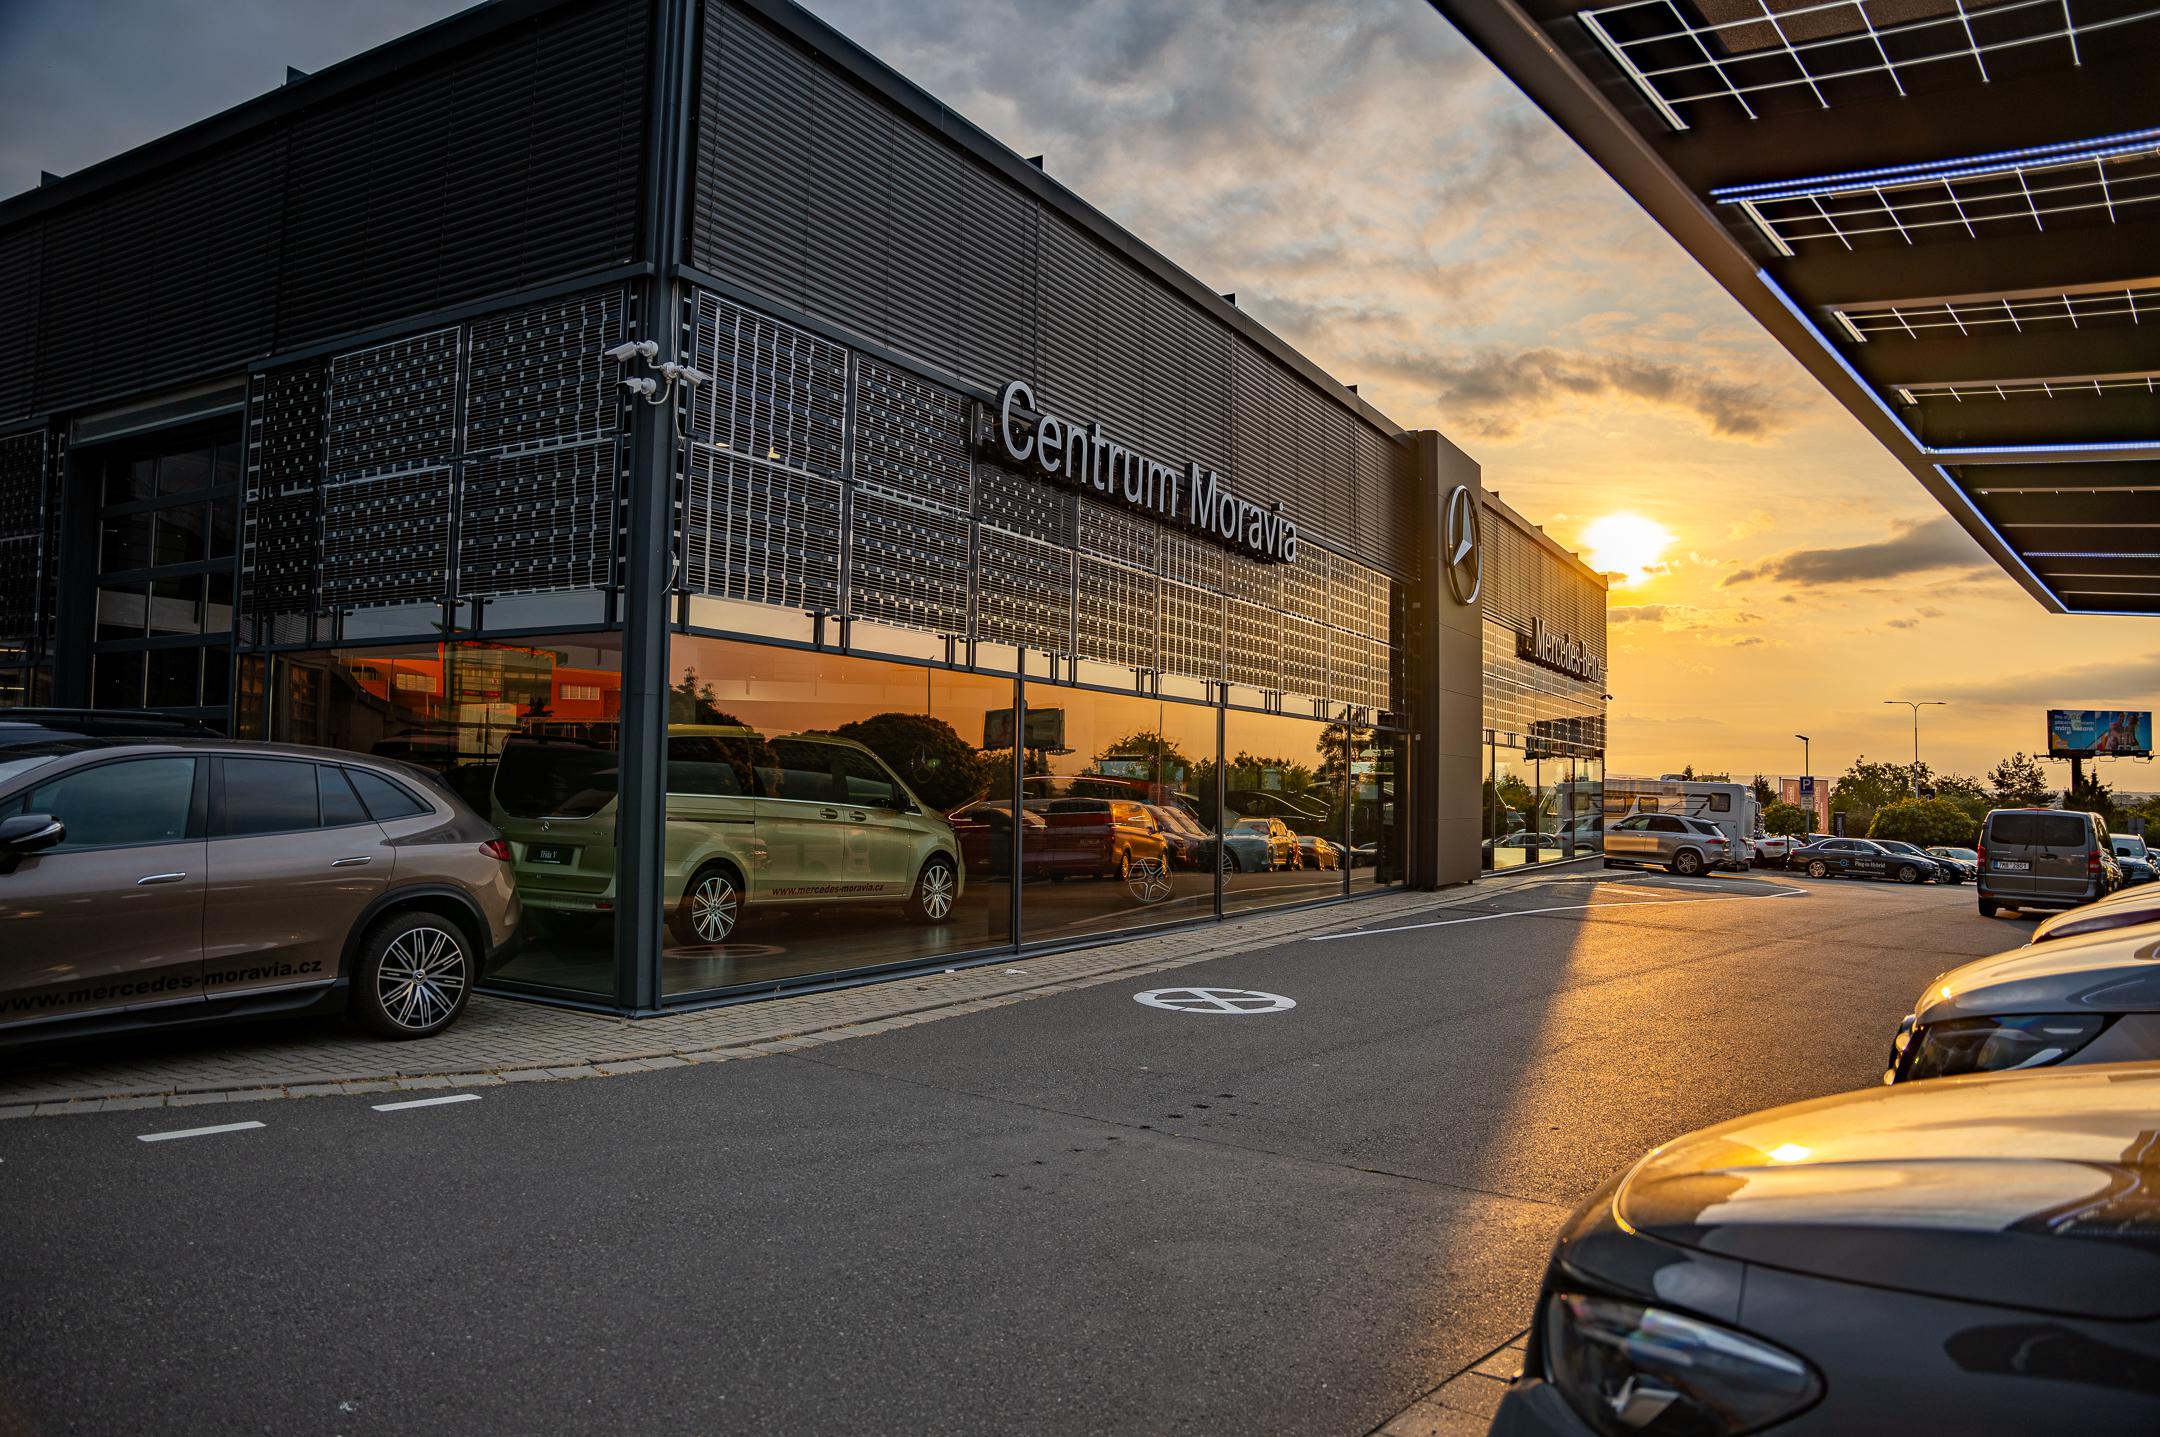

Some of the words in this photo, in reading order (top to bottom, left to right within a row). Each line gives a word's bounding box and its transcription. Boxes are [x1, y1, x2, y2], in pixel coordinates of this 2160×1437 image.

[1002, 380, 1177, 518] Centrum
[1190, 462, 1297, 563] Moravia
[1534, 616, 1601, 681] Mercedes-Benz
[1802, 778, 1811, 790] P
[772, 883, 884, 896] www.mercedes-moravia.cz
